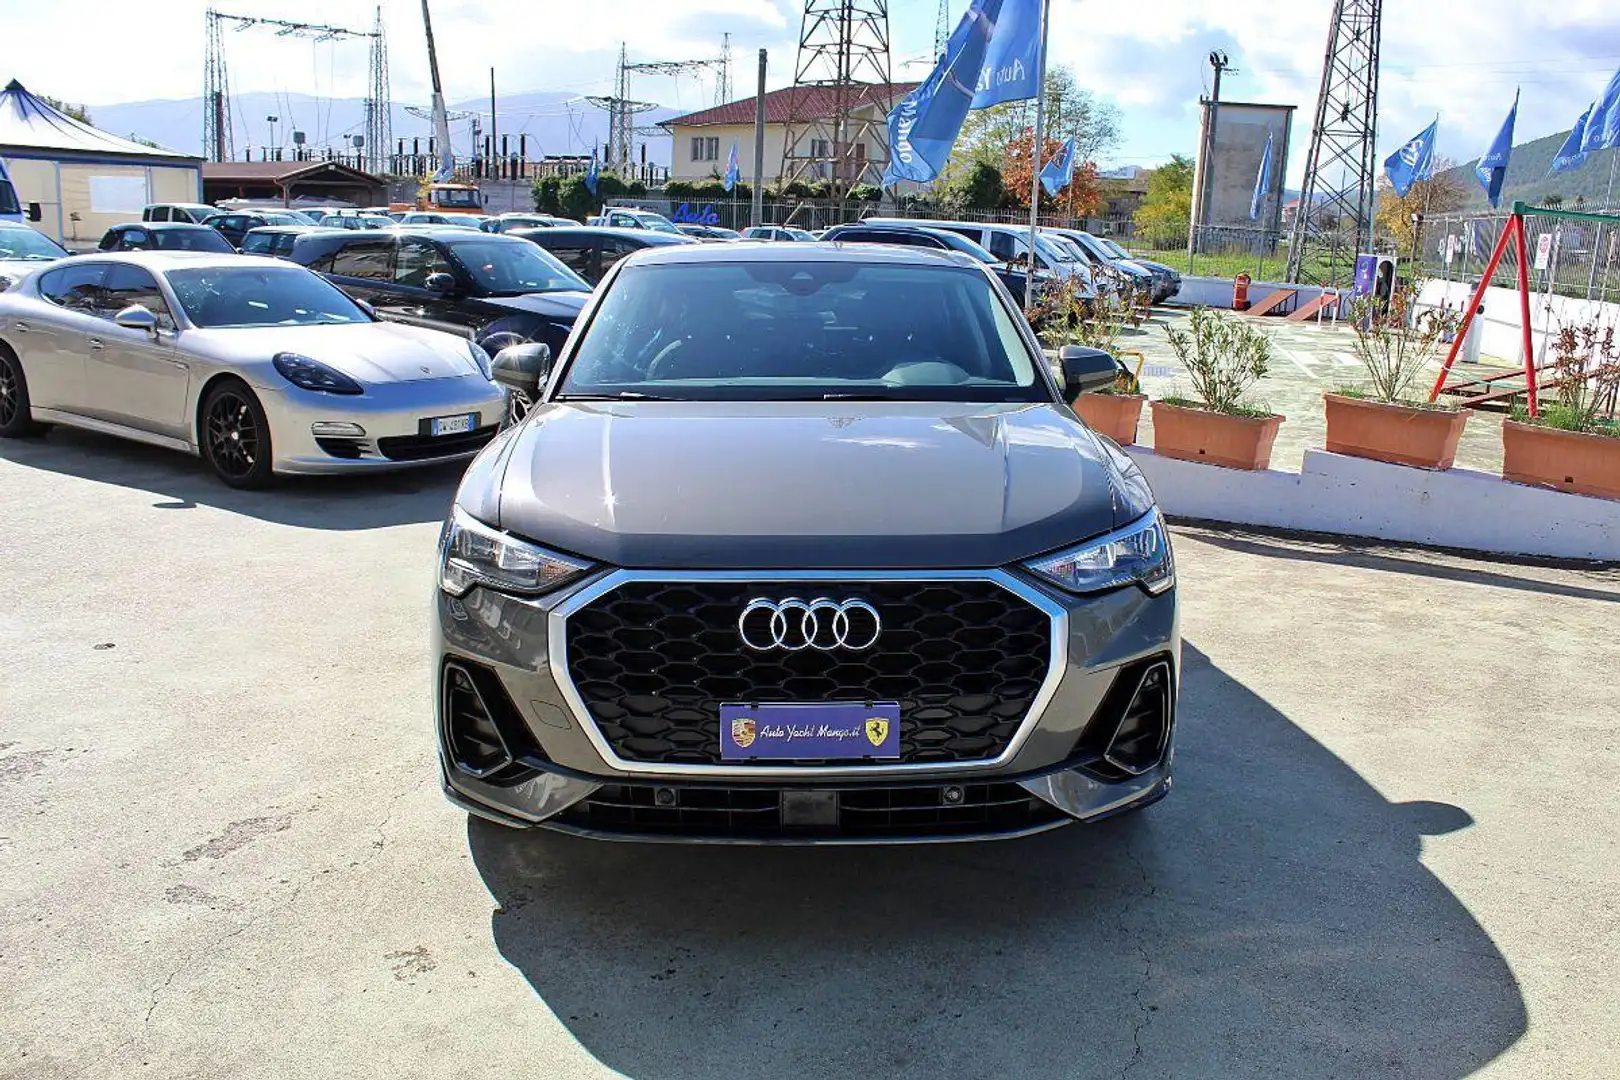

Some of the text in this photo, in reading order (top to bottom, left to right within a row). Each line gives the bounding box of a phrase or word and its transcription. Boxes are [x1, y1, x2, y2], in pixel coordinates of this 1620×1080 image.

[672, 202, 719, 225] Auto
[760, 723, 861, 742] Auto Yacht Mango.it
